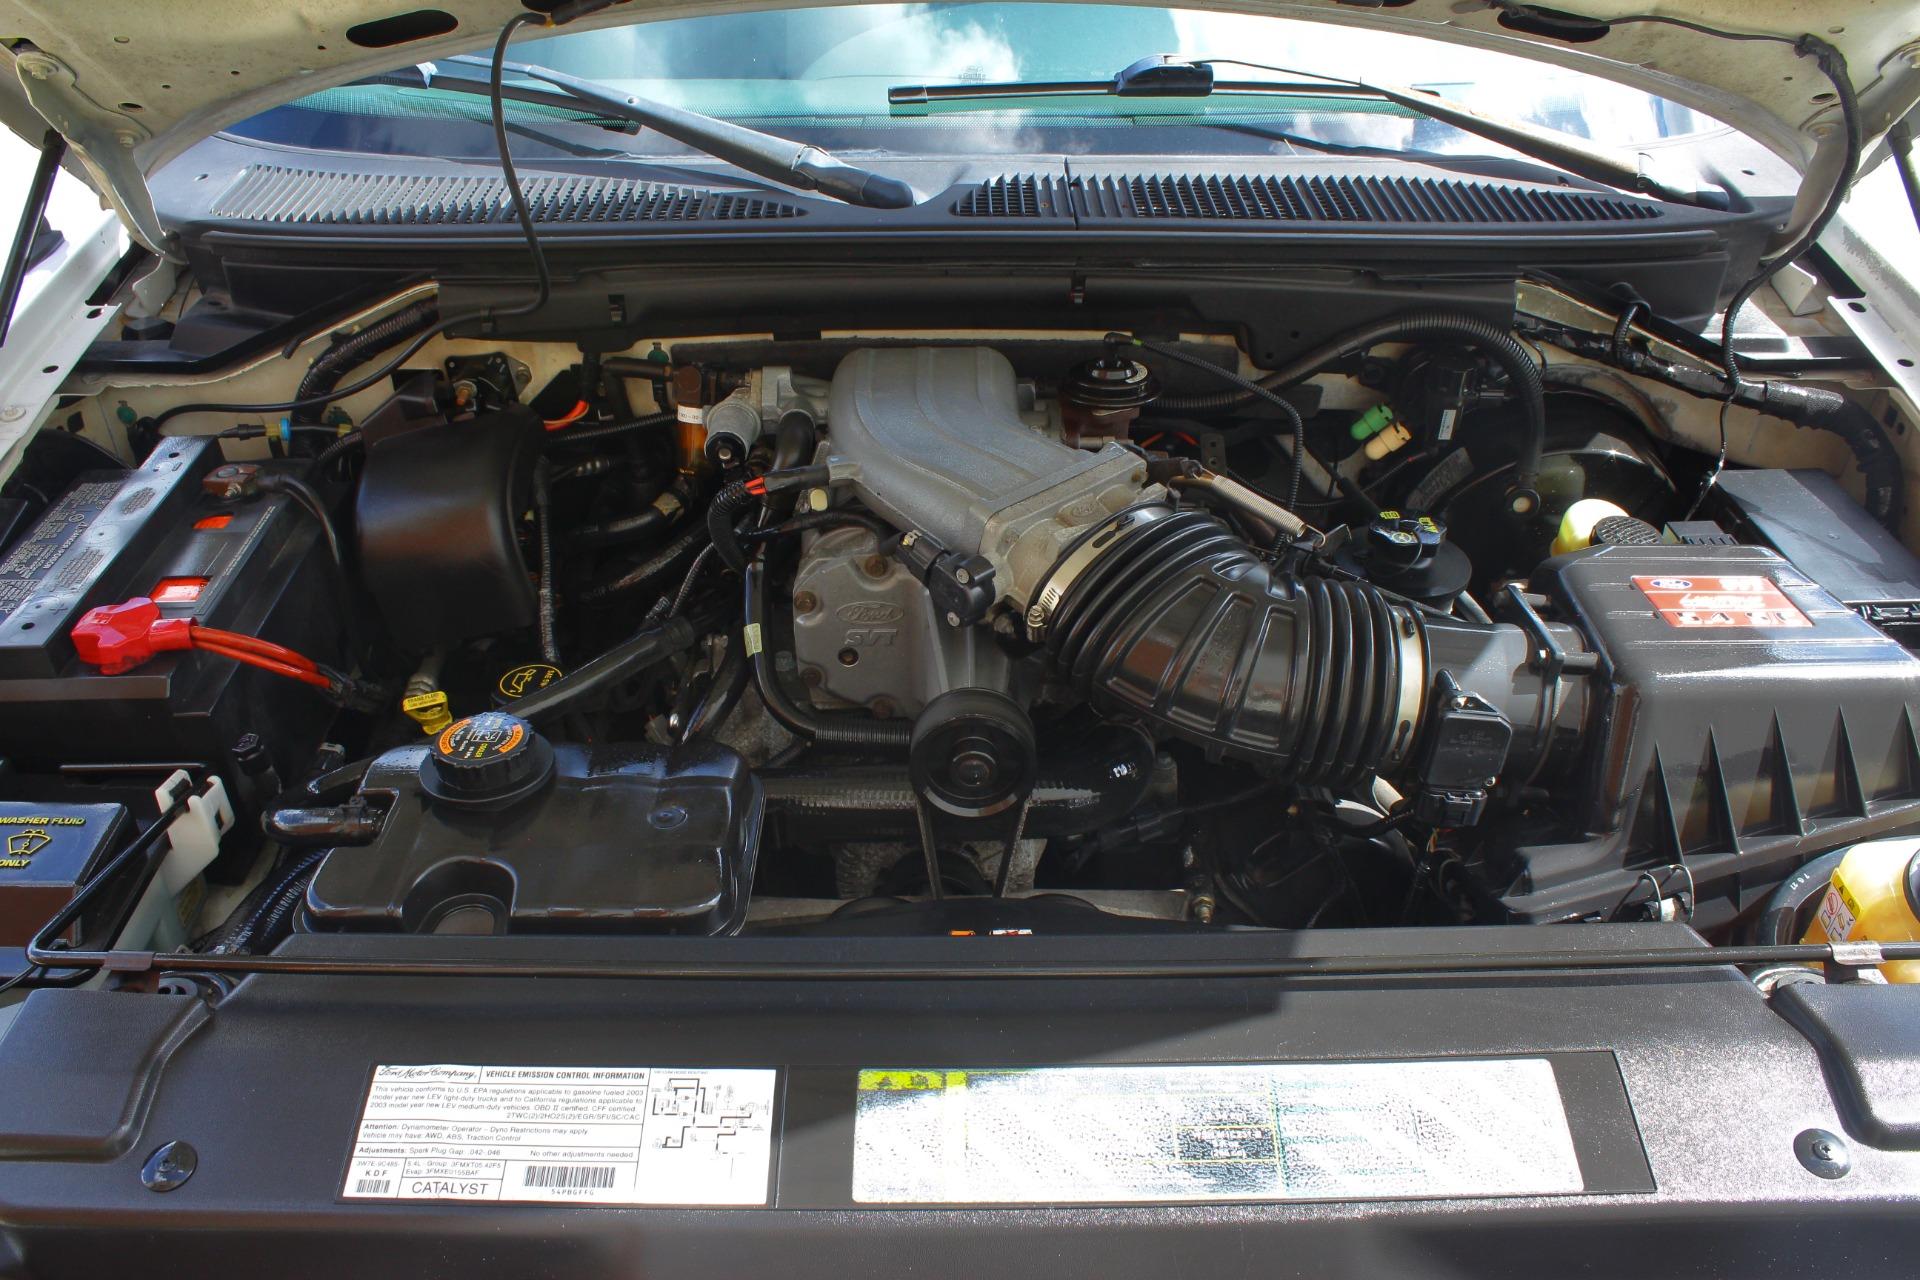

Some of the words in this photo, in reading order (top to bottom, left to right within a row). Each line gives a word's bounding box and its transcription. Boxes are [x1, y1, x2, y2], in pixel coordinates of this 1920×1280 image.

[845, 629, 898, 647] SVT
[0, 817, 49, 825] WASHER
[51, 817, 85, 825] FLUID
[400, 1067, 429, 1079] Motor
[486, 1070, 516, 1078] VEHICLE
[518, 1070, 554, 1079] EMISSION
[556, 1071, 591, 1079] CONTROL
[593, 1071, 645, 1080] INFORMATION
[528, 1088, 562, 1096] applicable
[443, 1094, 475, 1102] light-duty
[598, 1097, 634, 1105] applicable
[409, 1103, 425, 1111] year
[457, 1103, 501, 1111] medium-duty
[401, 1124, 449, 1132] Dynamometer
[451, 1125, 483, 1133] Operator
[490, 1126, 509, 1134] Dyno
[510, 1126, 551, 1134] Restrictions
[552, 1128, 568, 1136] may
[409, 1147, 429, 1155] Spark
[431, 1147, 447, 1155] Plug
[542, 1150, 561, 1158] other
[562, 1151, 605, 1159] adjustments
[411, 1181, 489, 1195] CATALYST
